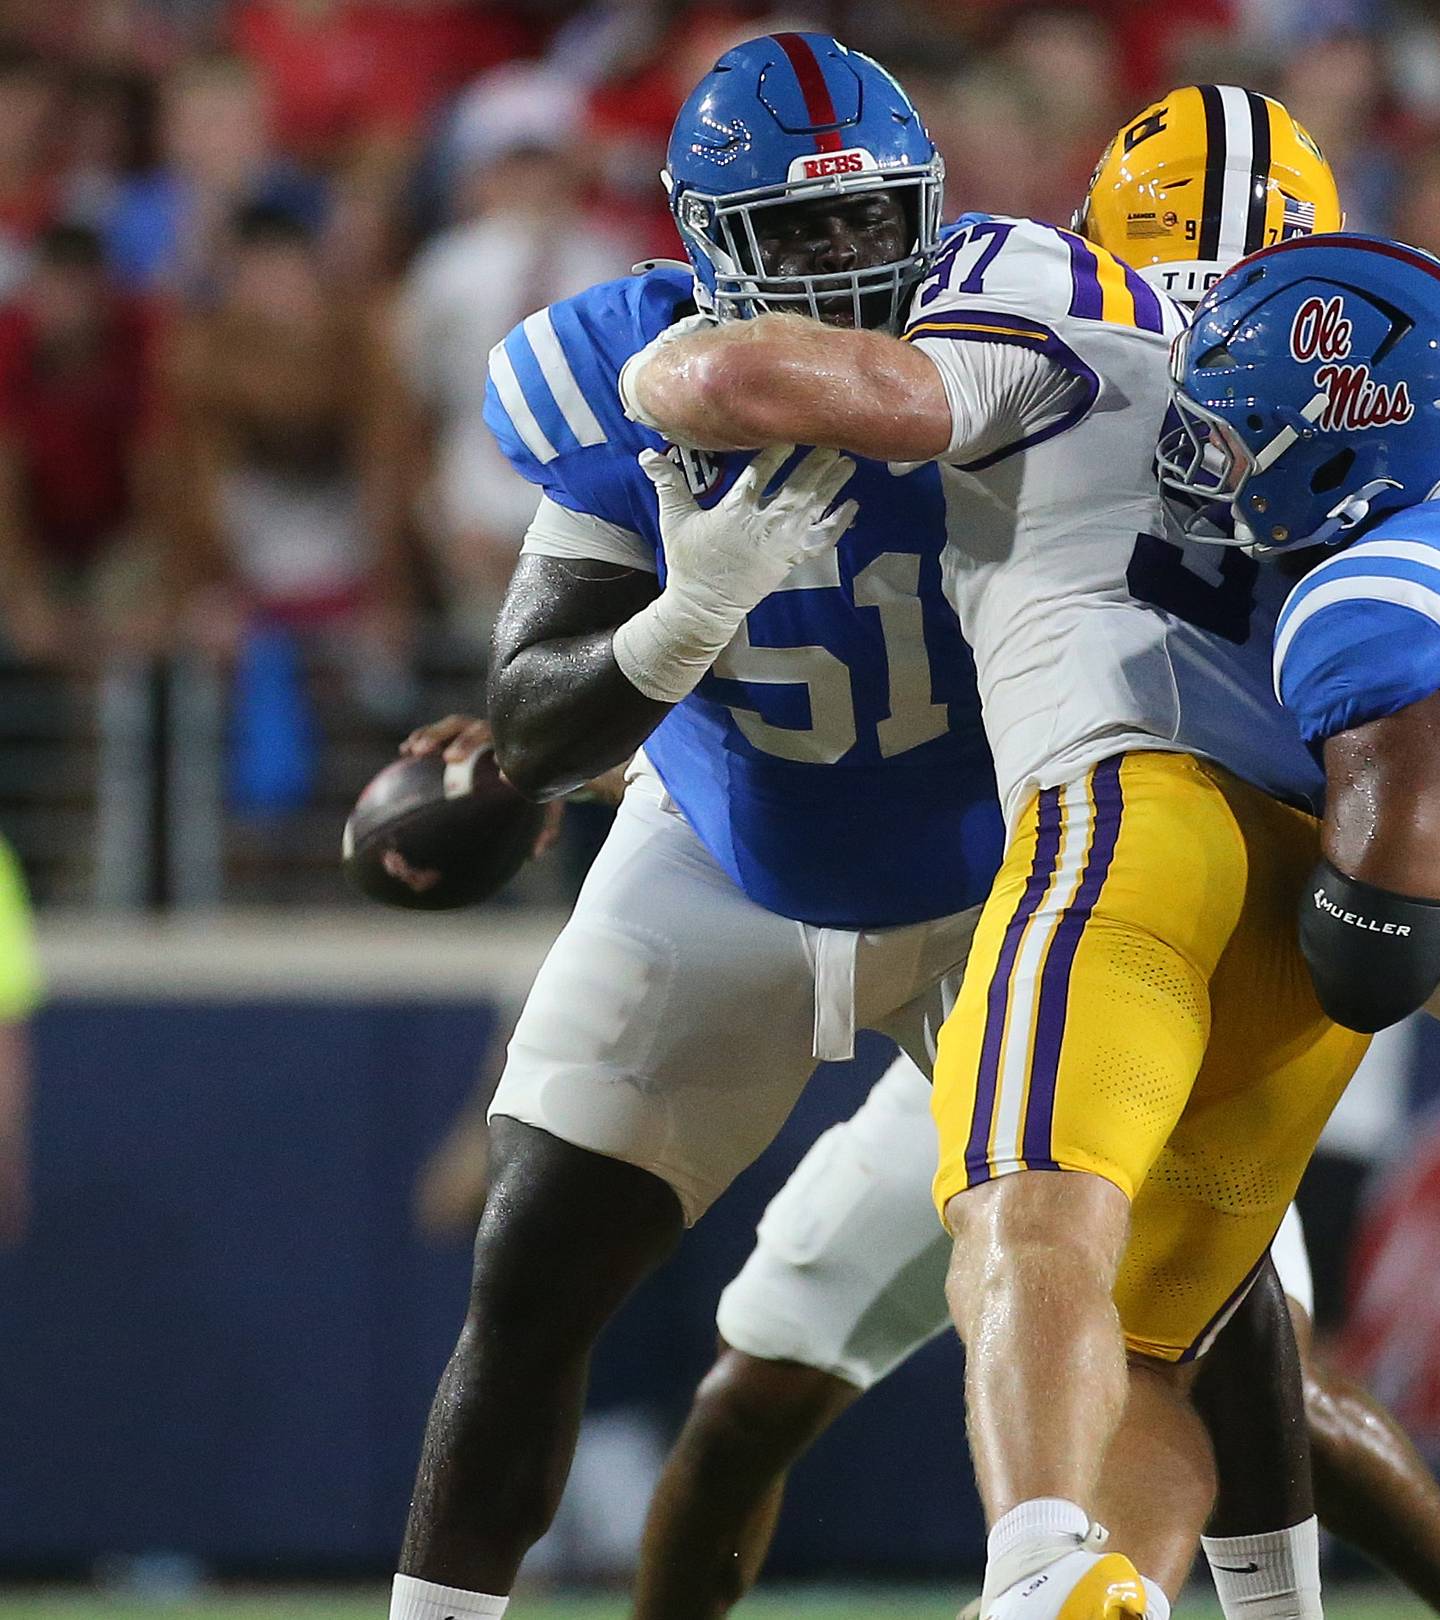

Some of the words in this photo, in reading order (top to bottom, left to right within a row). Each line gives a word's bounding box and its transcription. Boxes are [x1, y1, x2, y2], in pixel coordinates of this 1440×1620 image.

[804, 153, 863, 178] REBS
[1185, 220, 1196, 240] 9
[1290, 296, 1352, 363] Ole
[1314, 364, 1415, 432] Miss
[712, 546, 951, 766] 51
[1320, 897, 1412, 937] MUELLER
[1022, 1575, 1049, 1598] LSU
